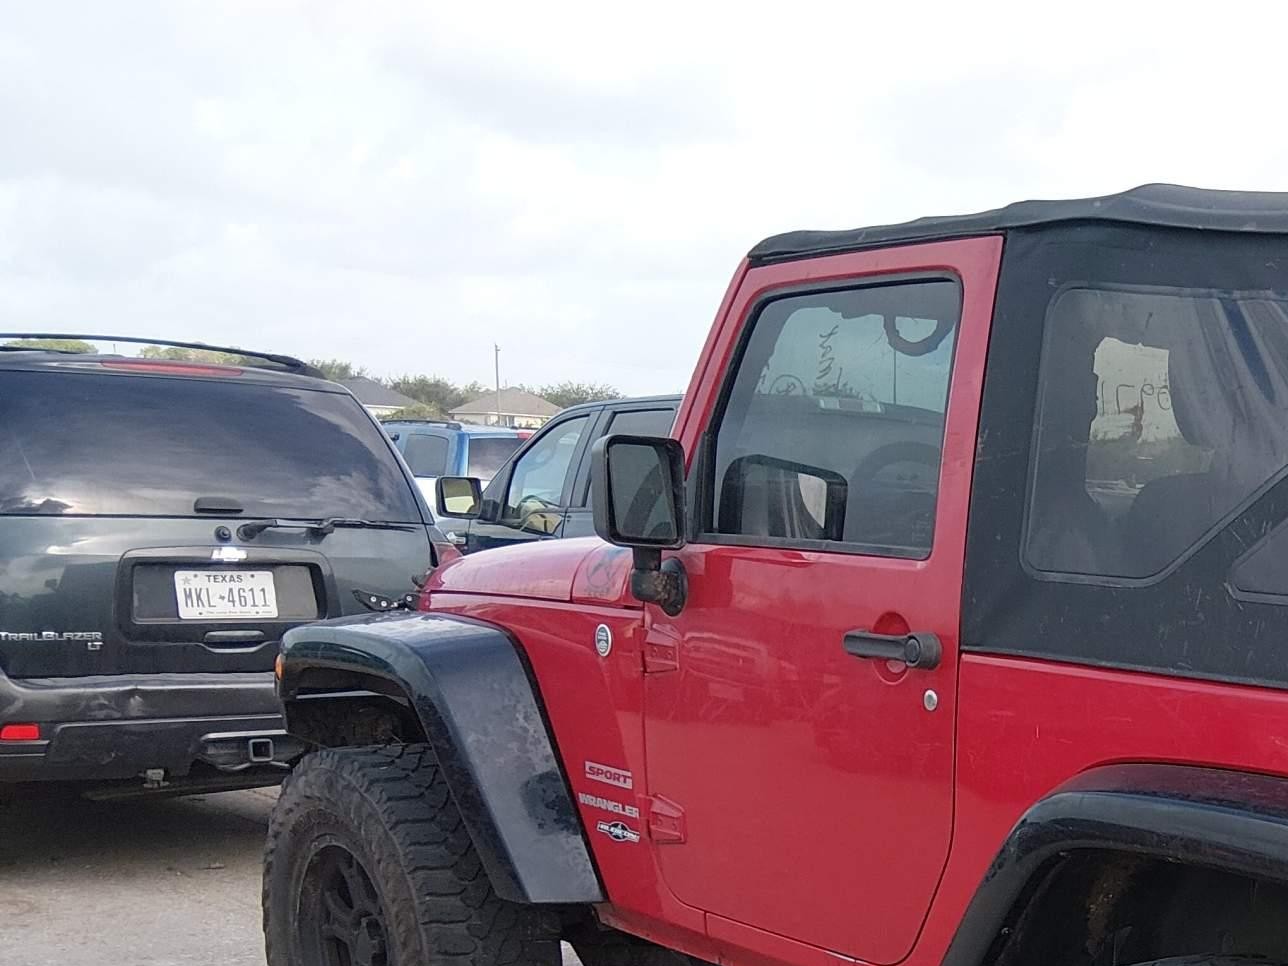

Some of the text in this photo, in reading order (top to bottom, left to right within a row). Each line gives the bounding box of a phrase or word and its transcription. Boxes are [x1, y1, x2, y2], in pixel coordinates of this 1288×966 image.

[205, 574, 244, 584] TEXAS
[183, 587, 271, 608] MKL 4611
[588, 765, 633, 784] SPORT
[578, 792, 640, 819] WRANGLER
